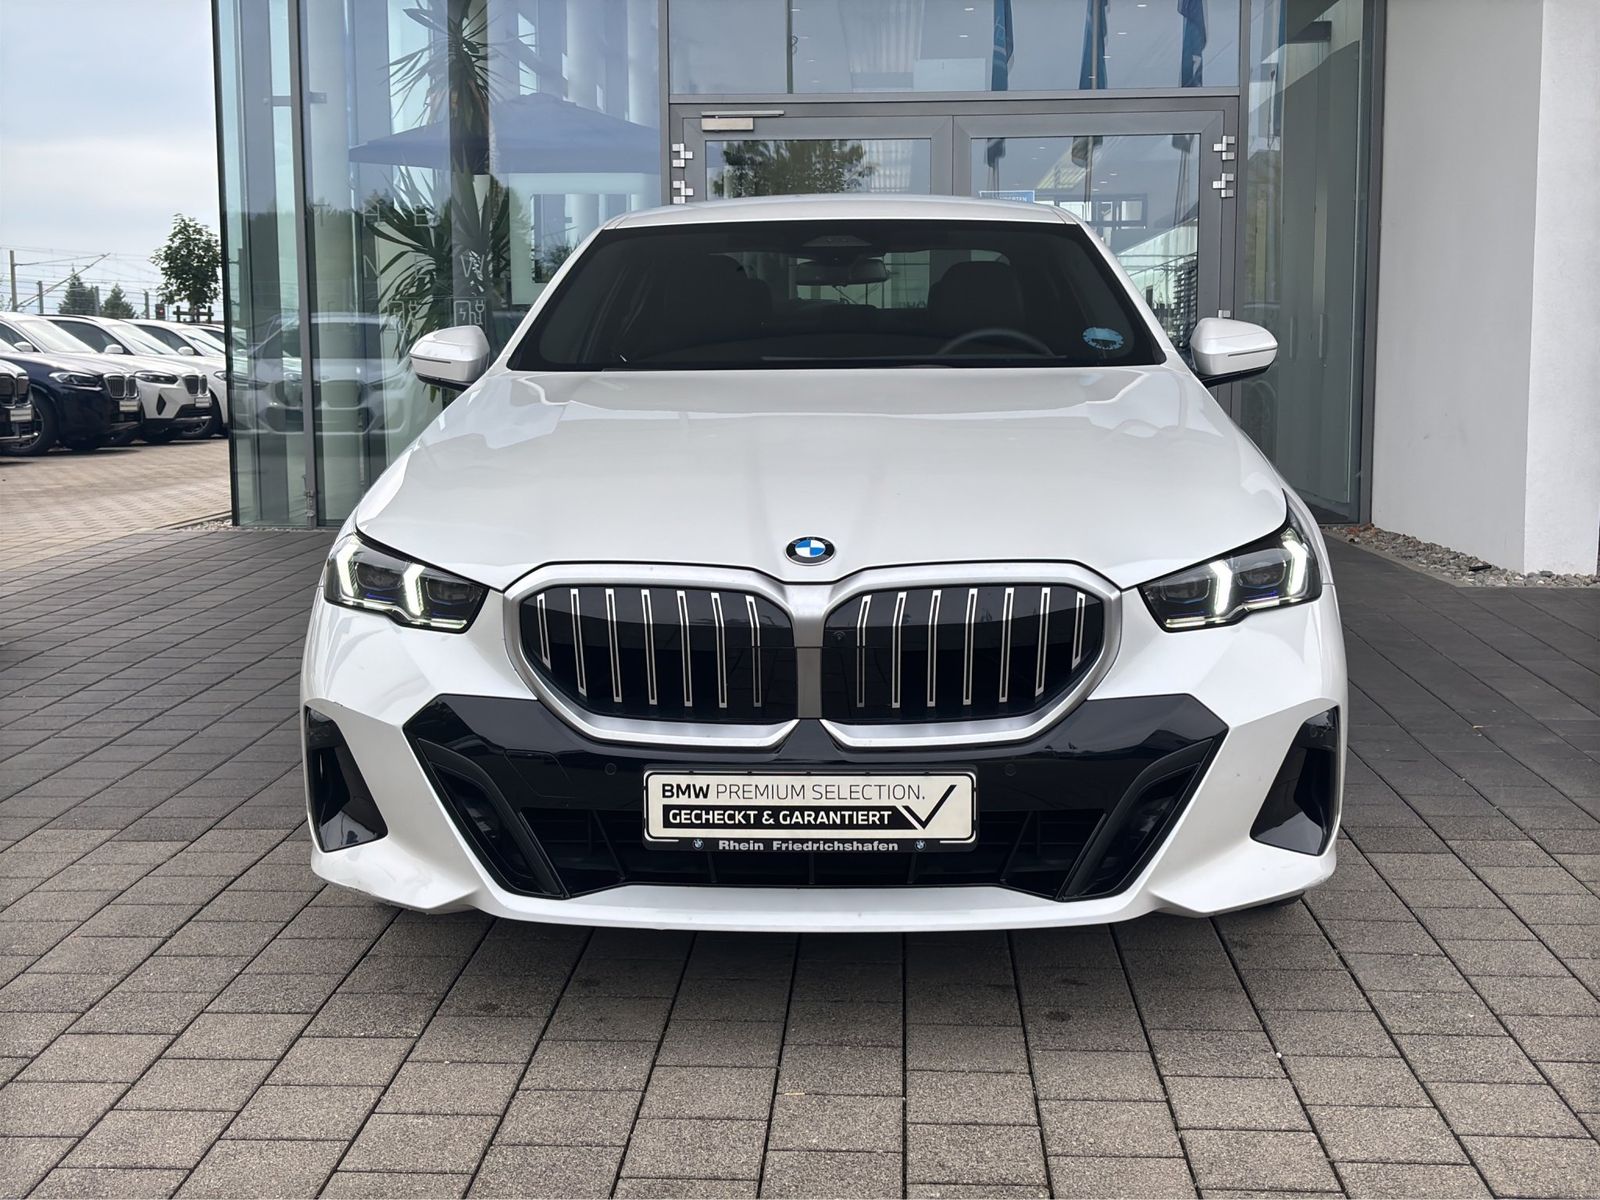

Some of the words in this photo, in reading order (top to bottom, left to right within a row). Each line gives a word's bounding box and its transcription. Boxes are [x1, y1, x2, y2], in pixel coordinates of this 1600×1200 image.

[661, 783, 710, 800] BMW
[716, 783, 806, 800] PREMIUM
[811, 783, 926, 801] SELECTION.
[669, 809, 758, 825] GECHECKT
[761, 810, 775, 825] &
[779, 809, 893, 825] GARANTIERT
[718, 839, 764, 851] Rhein
[772, 839, 899, 852] Friedrichshafen
